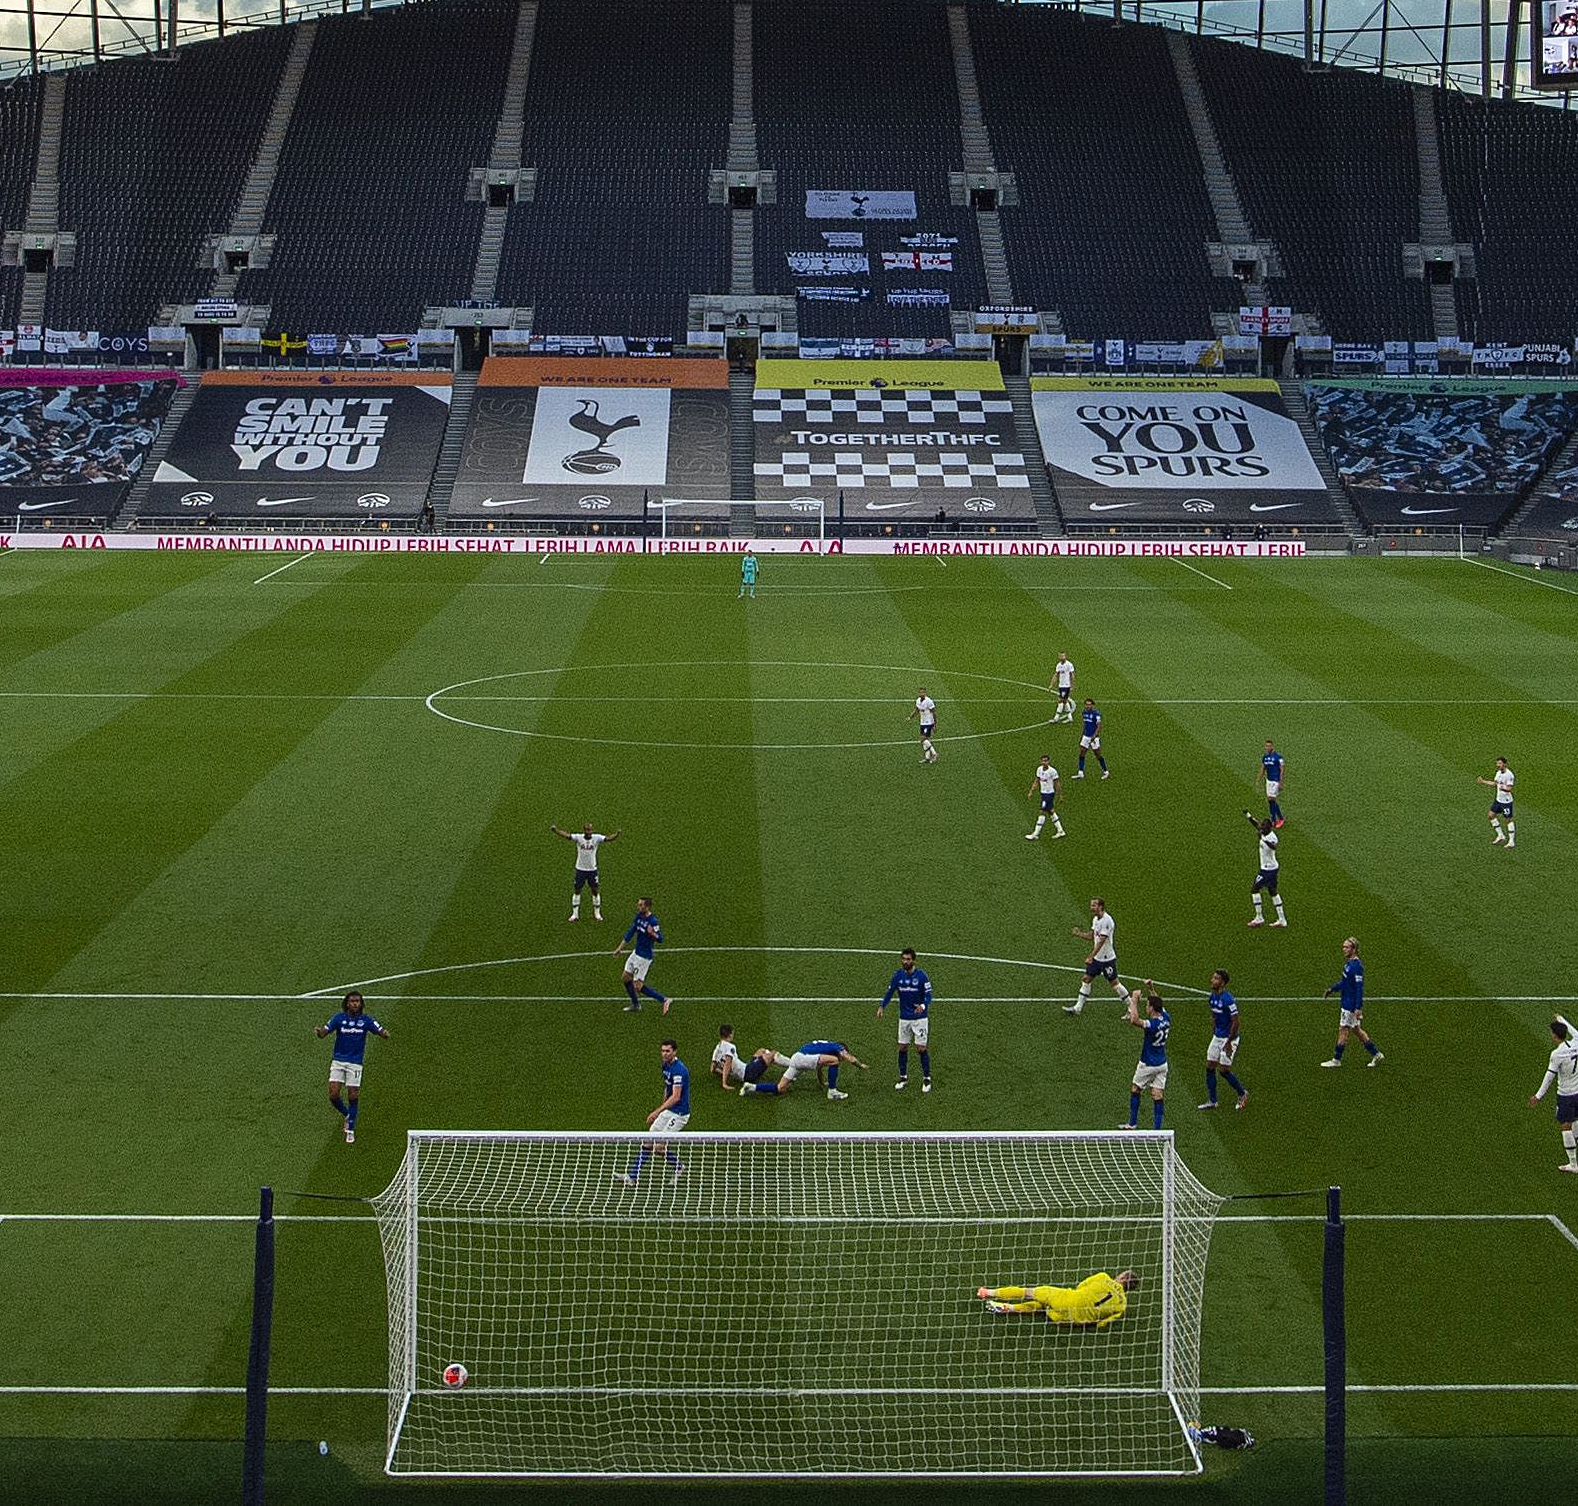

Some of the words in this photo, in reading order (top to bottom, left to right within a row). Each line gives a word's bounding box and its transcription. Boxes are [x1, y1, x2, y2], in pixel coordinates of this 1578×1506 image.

[98, 337, 148, 352] COYS
[1522, 344, 1561, 353] PUNJABI
[1335, 352, 1372, 361] SPURS
[1526, 353, 1554, 362] SPURS
[261, 374, 314, 384] Premier
[340, 374, 393, 385] League
[541, 375, 565, 384] WE
[567, 375, 596, 384] ARE
[598, 375, 628, 384] ONE
[630, 375, 673, 384] TEAM
[813, 378, 864, 387] Premier
[892, 378, 945, 388] League
[1088, 380, 1111, 389] WE
[1112, 380, 1144, 389] ARE
[1145, 380, 1175, 389] ONE
[1177, 380, 1218, 389] TEAM
[1452, 382, 1507, 394] League
[245, 398, 393, 416] CAN'T
[1076, 405, 1183, 422] COME
[1192, 405, 1247, 422] ON
[234, 416, 389, 433] SMILE
[234, 432, 383, 446] WITHOUT
[1080, 422, 1256, 455] YOU
[230, 445, 381, 471] YOU
[1091, 455, 1270, 478] SPURS
[1570, 1056, 1578, 1076] 7
[1094, 1292, 1113, 1307] 1
